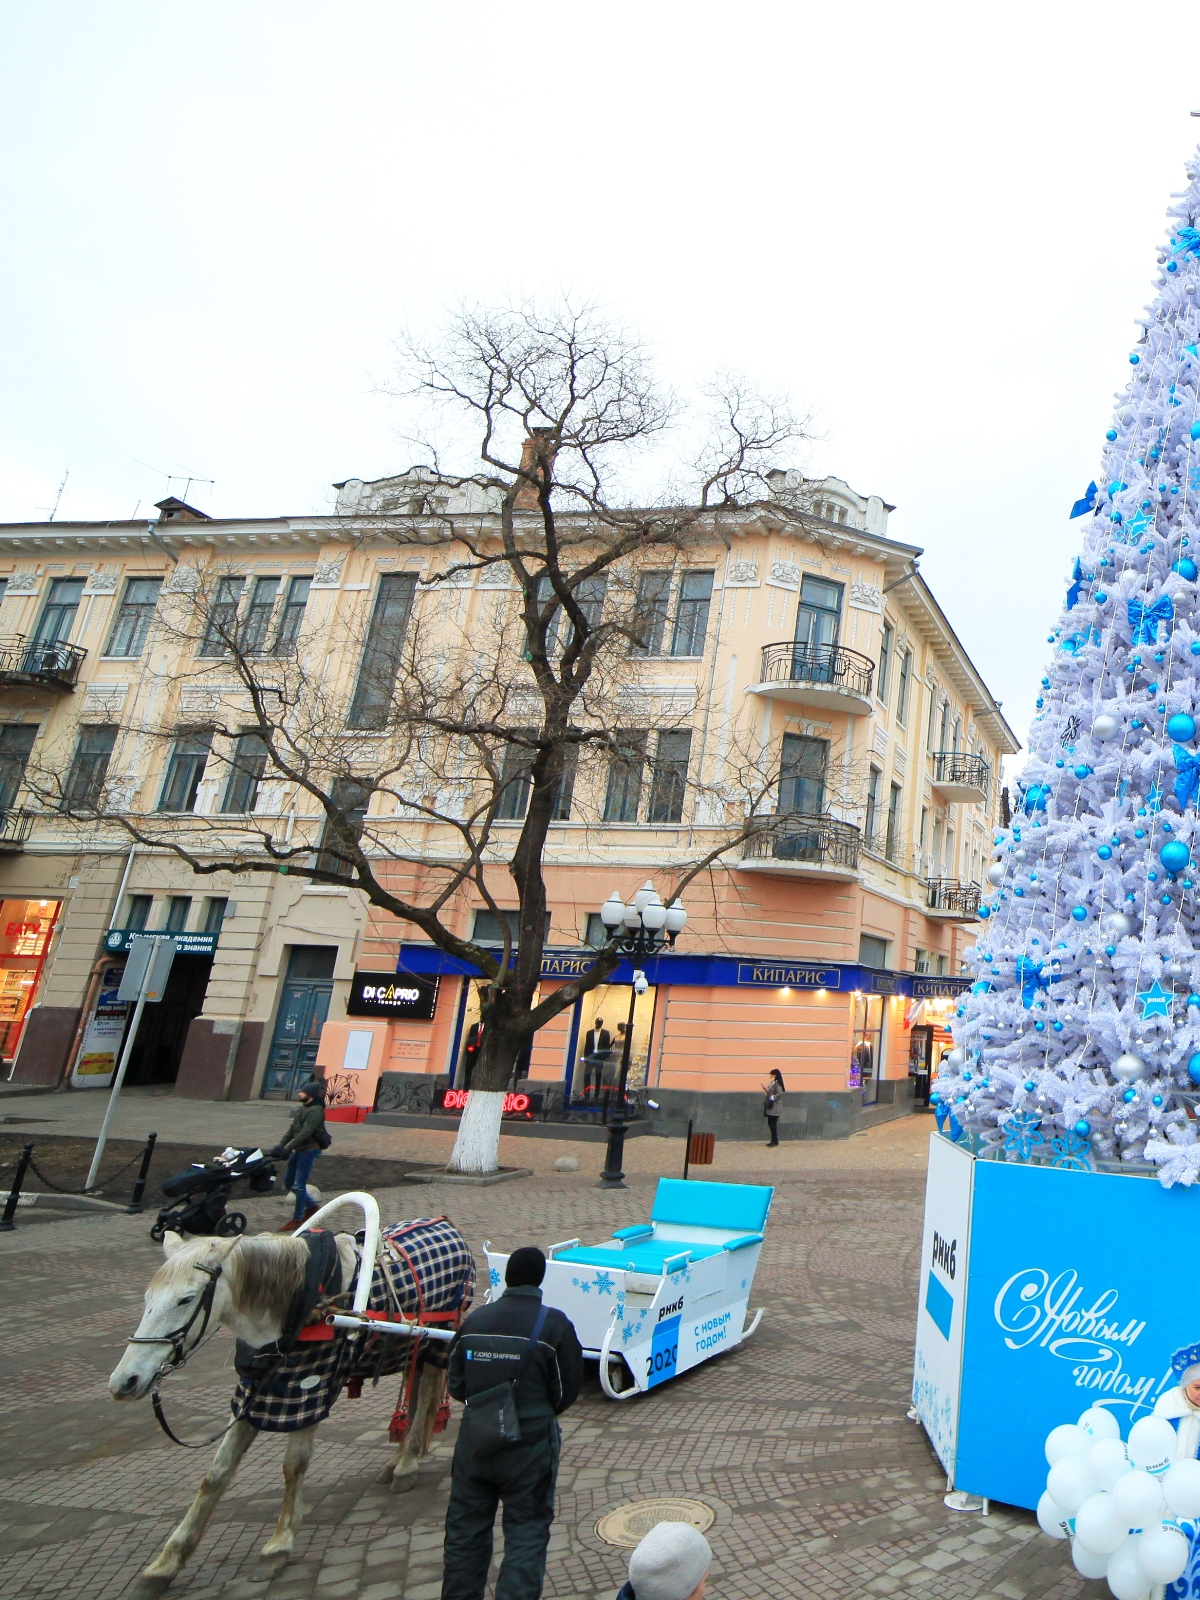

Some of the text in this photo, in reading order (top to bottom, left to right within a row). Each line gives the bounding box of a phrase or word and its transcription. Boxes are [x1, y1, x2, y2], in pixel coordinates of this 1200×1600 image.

[540, 959, 591, 974] ПАРИС
[752, 967, 827, 985] КИПАРИС
[931, 1229, 958, 1280] рнкб
[658, 1294, 684, 1322] рнкб
[993, 1267, 1147, 1350] С Новым
[694, 1312, 731, 1337] С НОВЫМ
[695, 1325, 727, 1352] ГОДОМ!
[492, 1352, 521, 1360] SHIPPING
